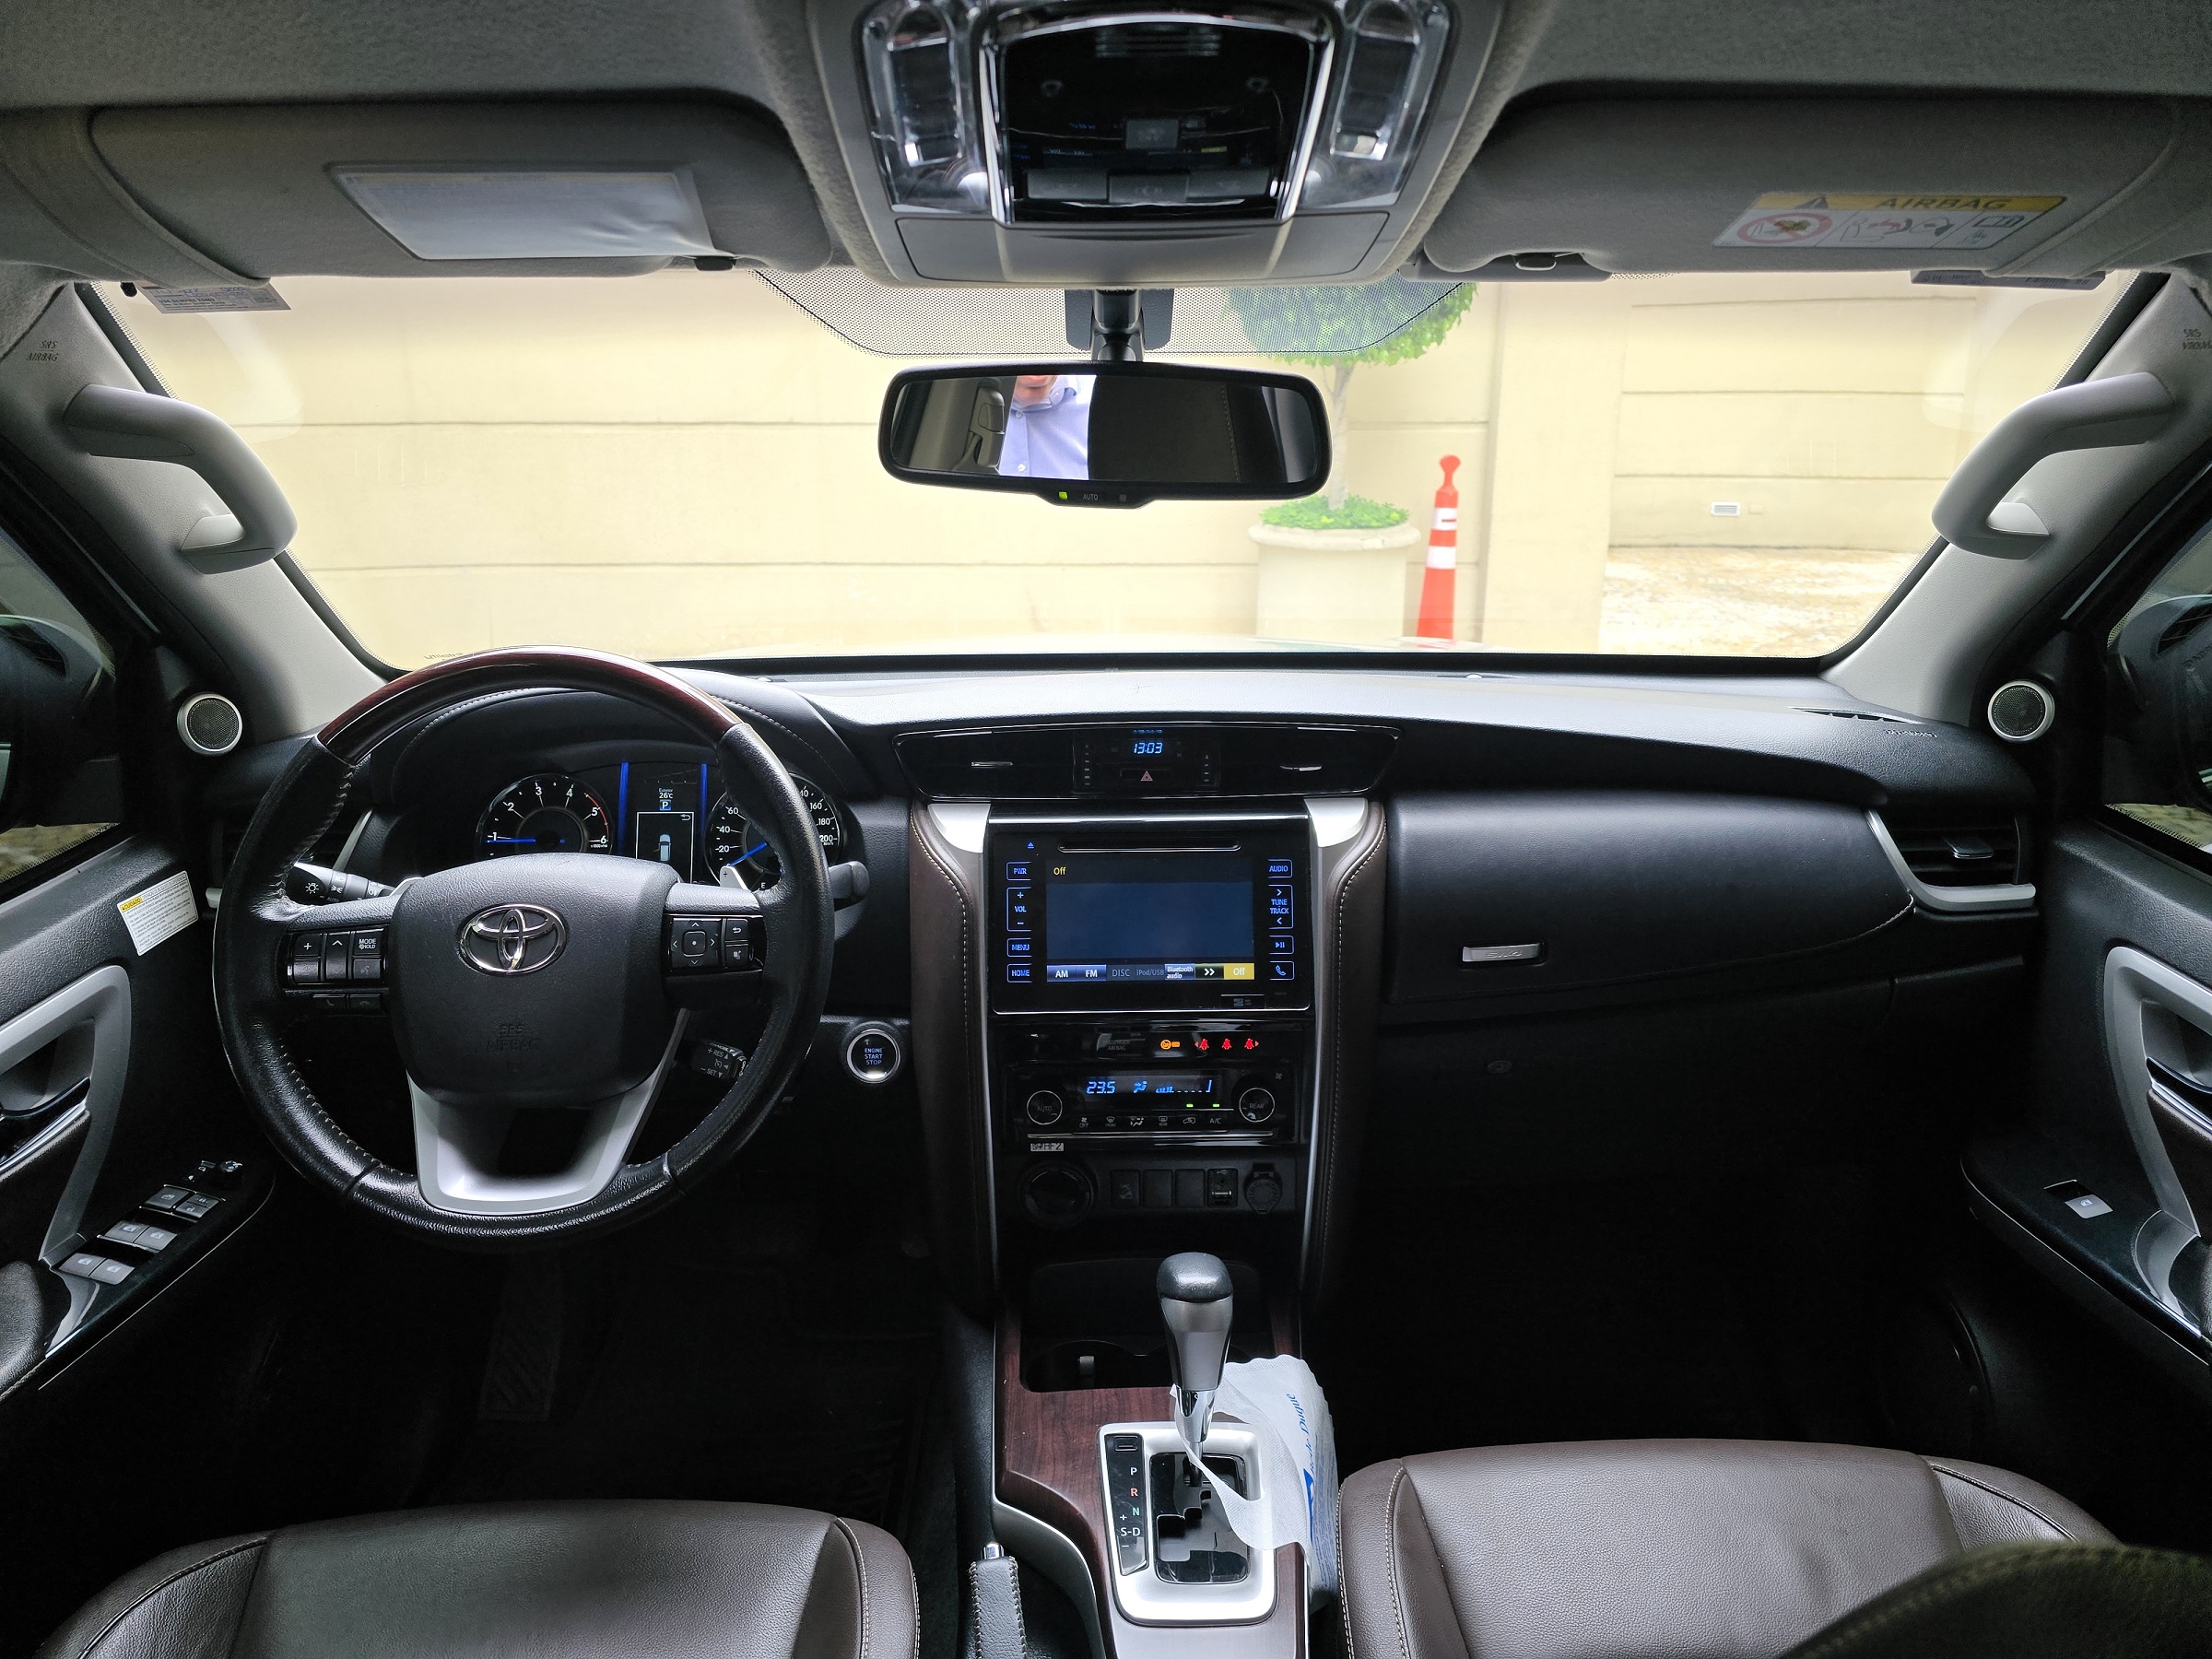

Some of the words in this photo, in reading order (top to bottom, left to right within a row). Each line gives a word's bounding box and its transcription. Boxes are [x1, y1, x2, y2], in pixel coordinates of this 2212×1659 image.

[1874, 197, 2011, 211] AIRBAG
[40, 340, 58, 349] SRS
[26, 352, 59, 362] AIRBAG
[1133, 742, 1163, 754] 13:03
[535, 785, 543, 796] 3
[566, 788, 573, 798] 4
[507, 802, 515, 812] 2
[662, 801, 669, 810] P
[809, 802, 822, 810] 160
[591, 806, 599, 817] 5
[727, 806, 739, 815] 60
[818, 818, 831, 826] 180
[719, 825, 731, 833] 40
[600, 835, 606, 844] 6
[819, 834, 833, 842] 200
[1053, 866, 1067, 876] Off
[1269, 865, 1288, 873] AUDIO
[1014, 905, 1027, 913] VOL
[1269, 907, 1289, 915] TRACK
[1085, 969, 1098, 978] FM
[1112, 968, 1131, 977] DISC
[1135, 968, 1165, 977] iPod/USB
[1166, 965, 1194, 973] Bluetooth
[1233, 967, 1246, 976] Off
[1055, 969, 1069, 979] AM
[712, 1049, 724, 1058] RES
[706, 1067, 718, 1077] SET
[1086, 1080, 1116, 1094] 23.5
[1286, 1393, 1309, 1435] Duque
[1130, 1467, 1138, 1476] P
[1130, 1488, 1138, 1497] R
[1132, 1507, 1140, 1516] N
[1120, 1527, 1141, 1536] S-D
